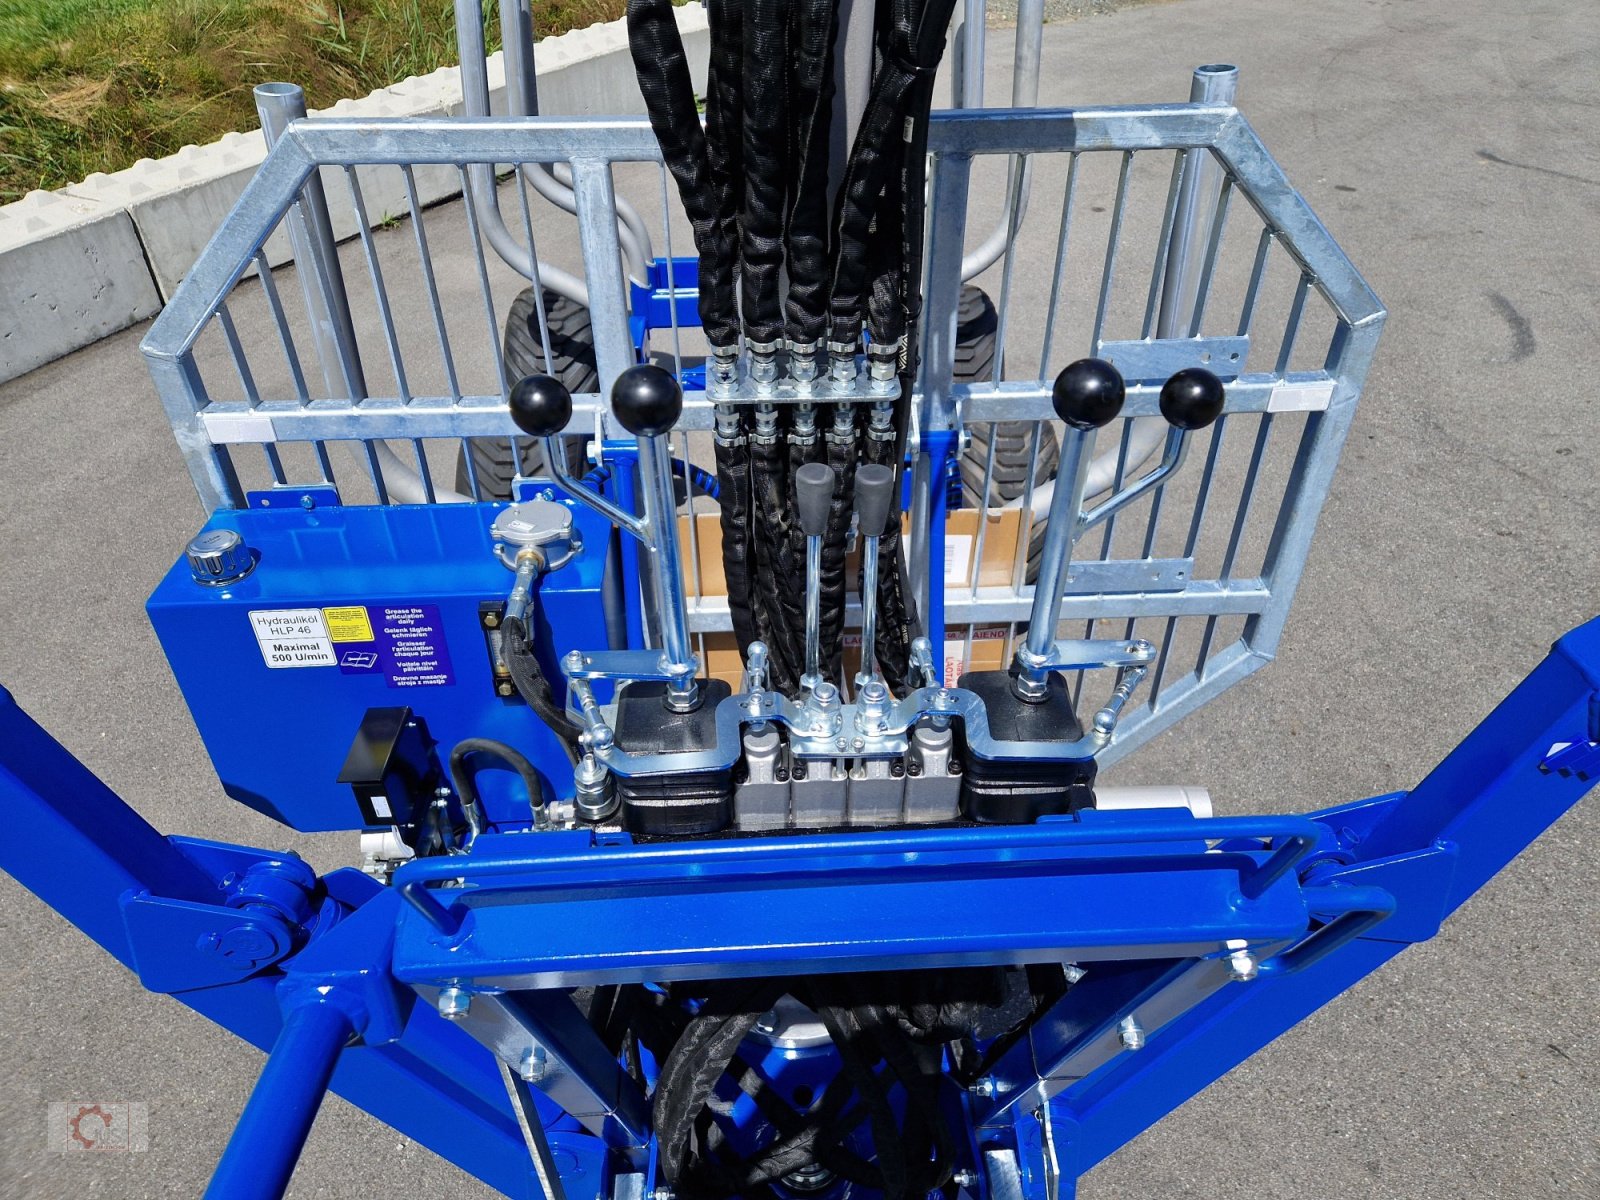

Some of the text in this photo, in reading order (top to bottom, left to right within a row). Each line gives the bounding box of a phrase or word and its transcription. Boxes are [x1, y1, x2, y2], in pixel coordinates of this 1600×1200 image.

[256, 615, 318, 627] Hydrauliköl
[270, 625, 312, 635] HLP 46
[273, 642, 321, 652] Maximal
[271, 652, 329, 662] 500 U/min
